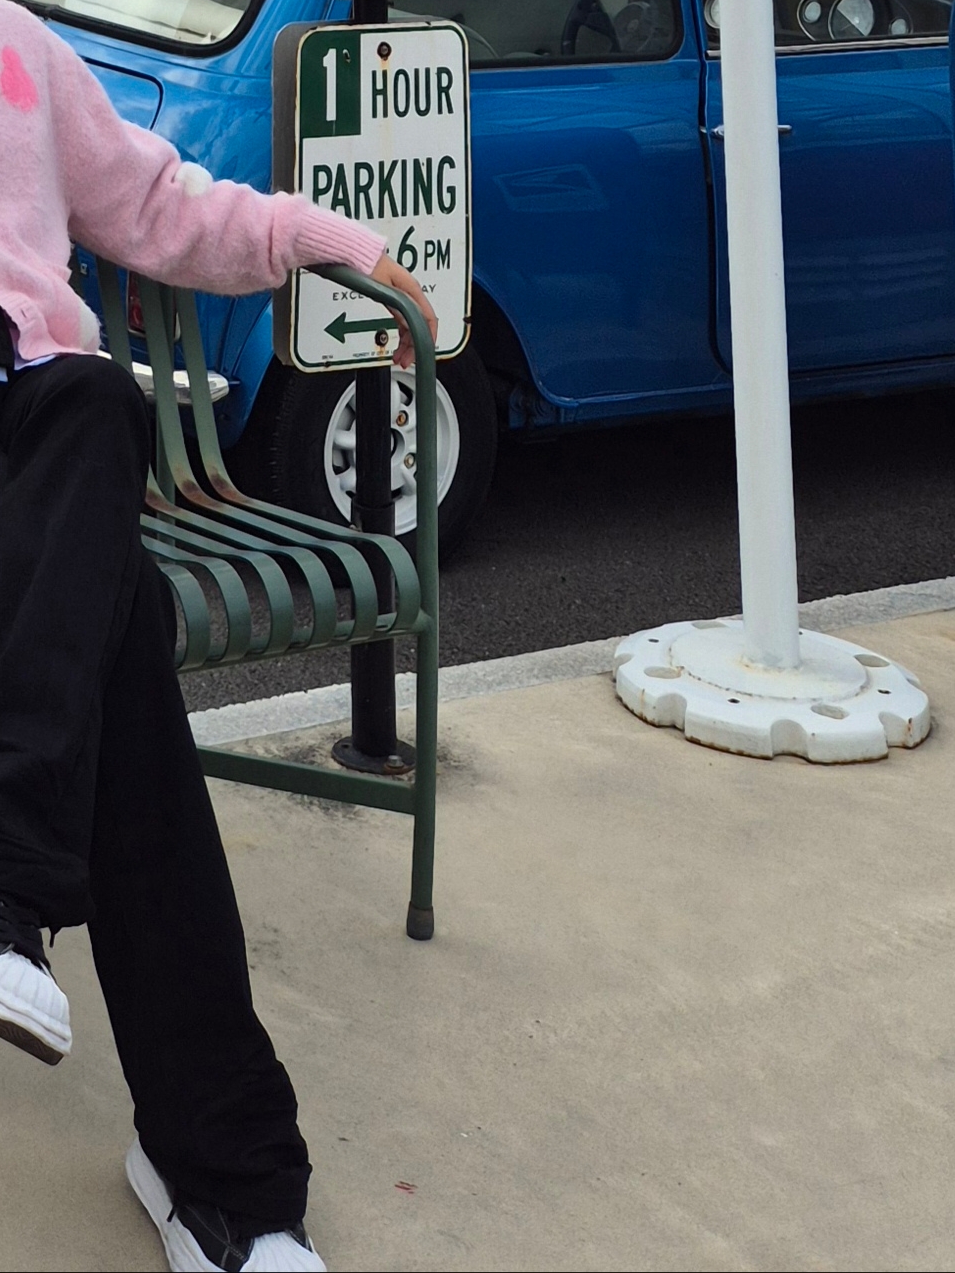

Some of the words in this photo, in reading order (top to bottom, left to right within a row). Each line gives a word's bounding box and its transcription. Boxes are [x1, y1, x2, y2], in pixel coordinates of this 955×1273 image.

[323, 48, 337, 122] 1
[371, 67, 454, 119] HOUR
[312, 155, 457, 220] PARKING
[423, 238, 452, 271] PM
